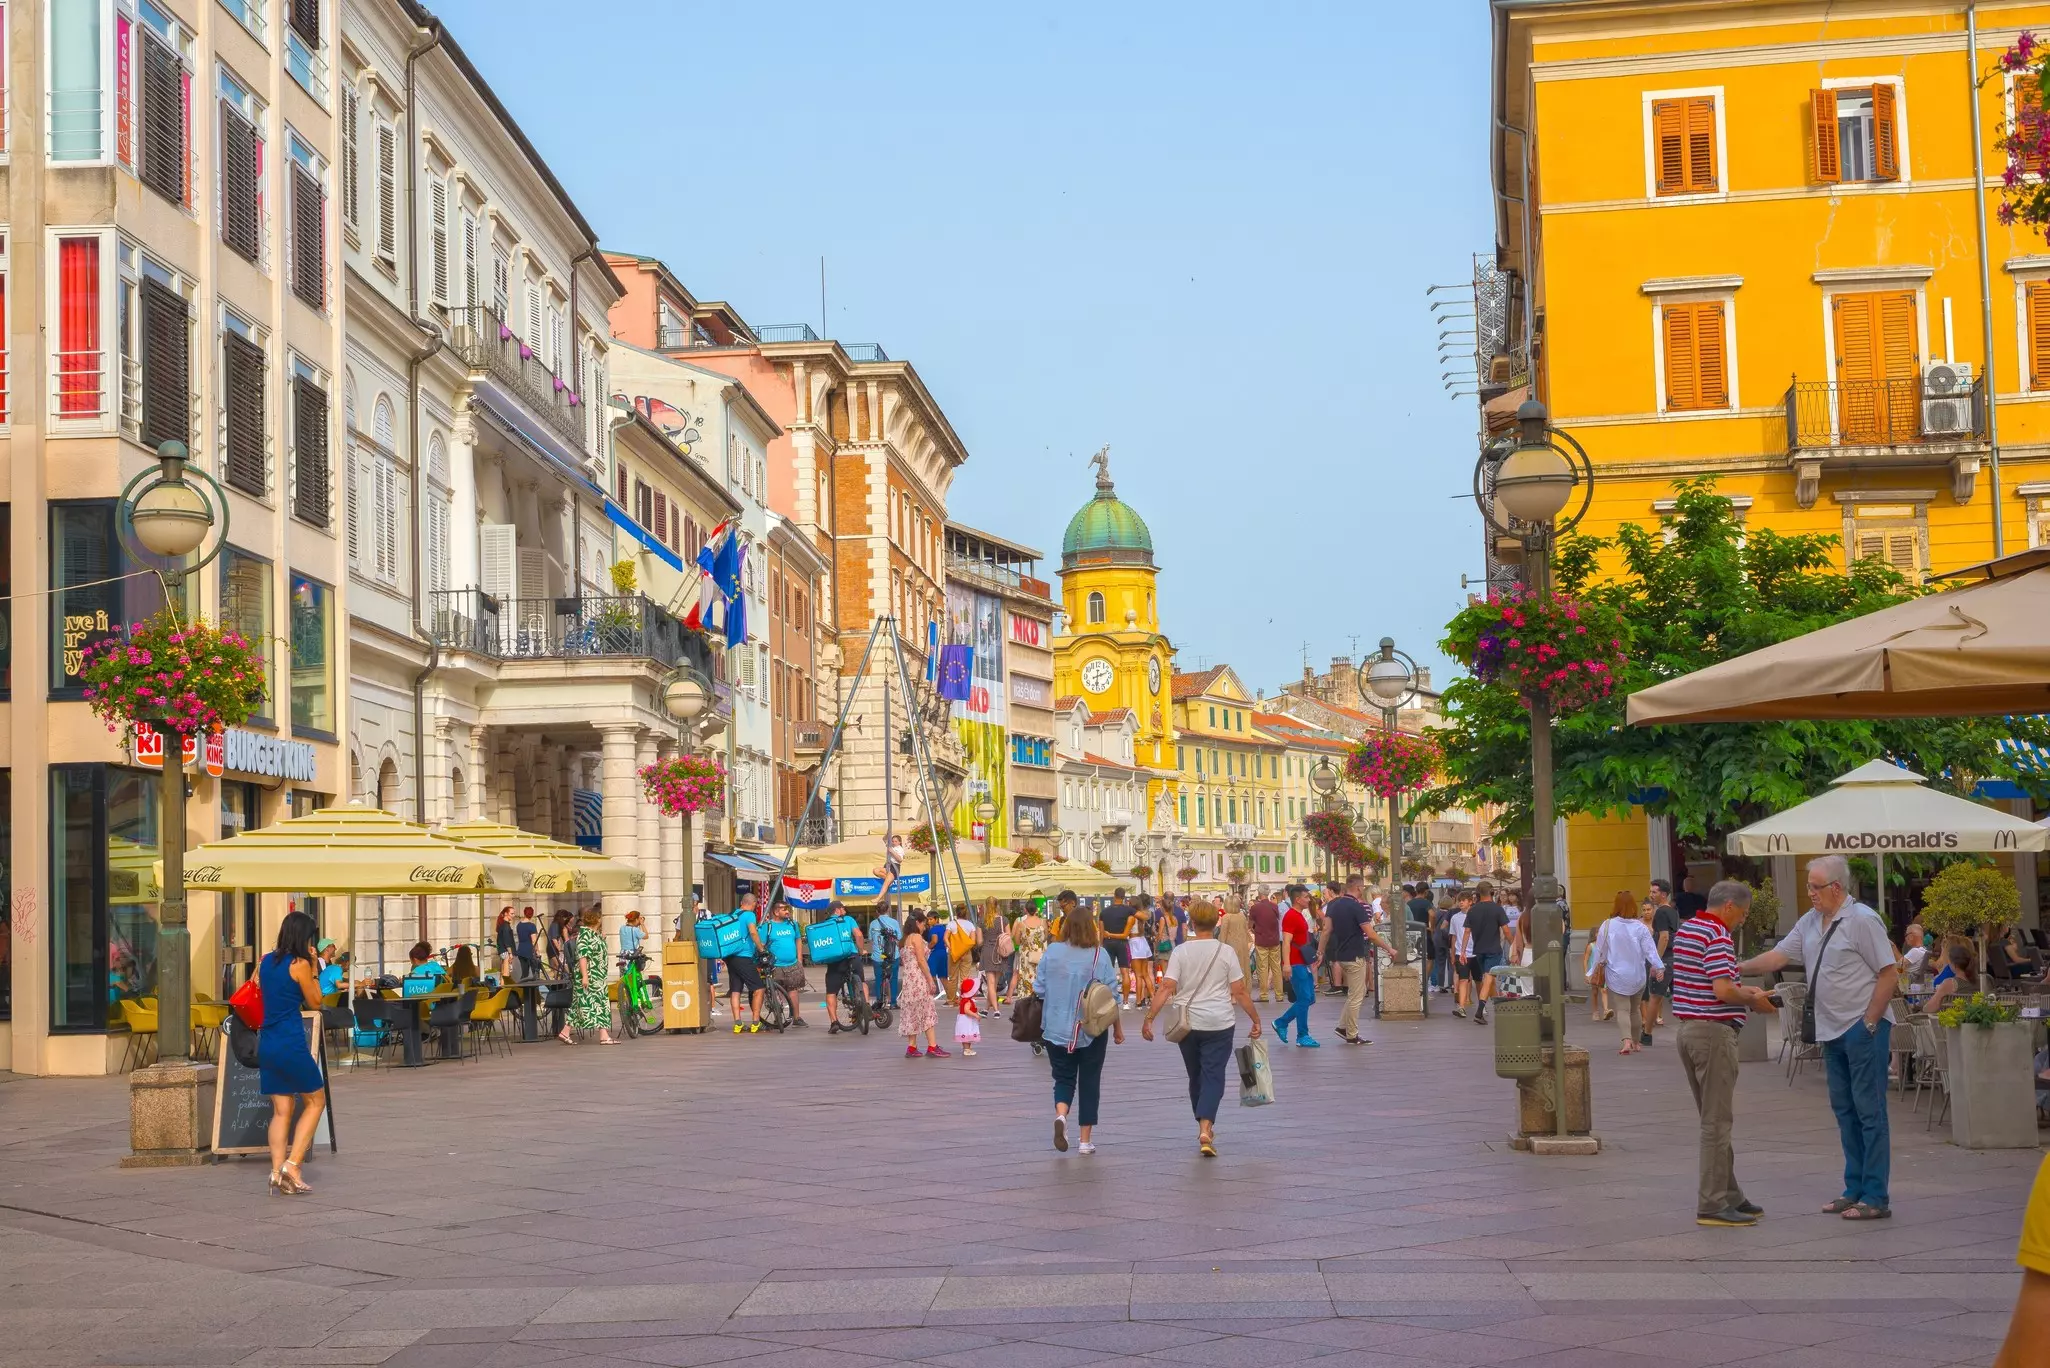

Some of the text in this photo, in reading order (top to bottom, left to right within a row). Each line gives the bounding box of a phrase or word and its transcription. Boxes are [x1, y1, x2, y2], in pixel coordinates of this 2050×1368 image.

[1013, 615, 1039, 646] NKD
[137, 735, 196, 754] KIG
[207, 745, 224, 765] KING
[227, 729, 316, 781] BURGER KING
[1824, 831, 1958, 850] McDonald's
[723, 929, 740, 941] Wolt
[813, 936, 834, 948] Wolt
[408, 985, 428, 994] Wolt
